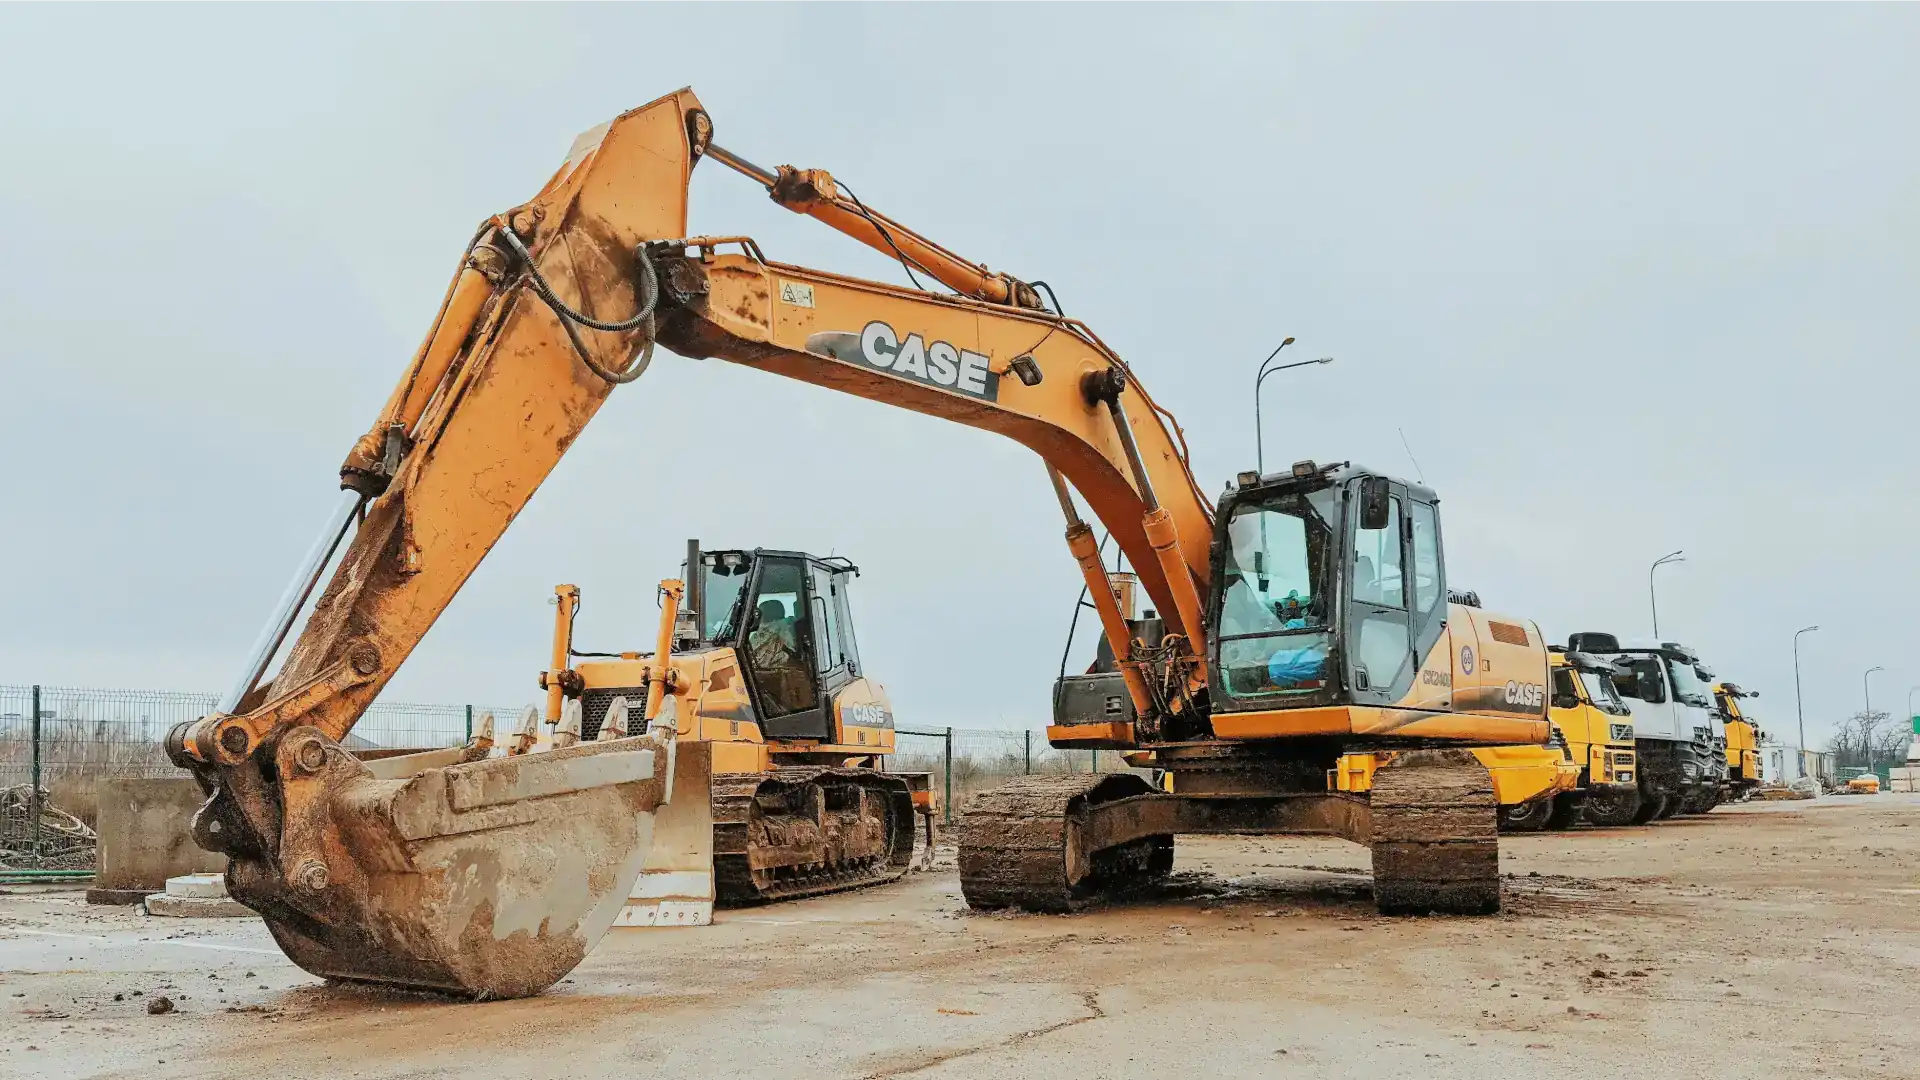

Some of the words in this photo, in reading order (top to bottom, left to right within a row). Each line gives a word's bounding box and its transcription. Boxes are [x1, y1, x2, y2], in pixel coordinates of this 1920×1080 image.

[861, 321, 990, 395] CASE
[1505, 680, 1543, 707] CASE
[852, 702, 885, 724] CASE
